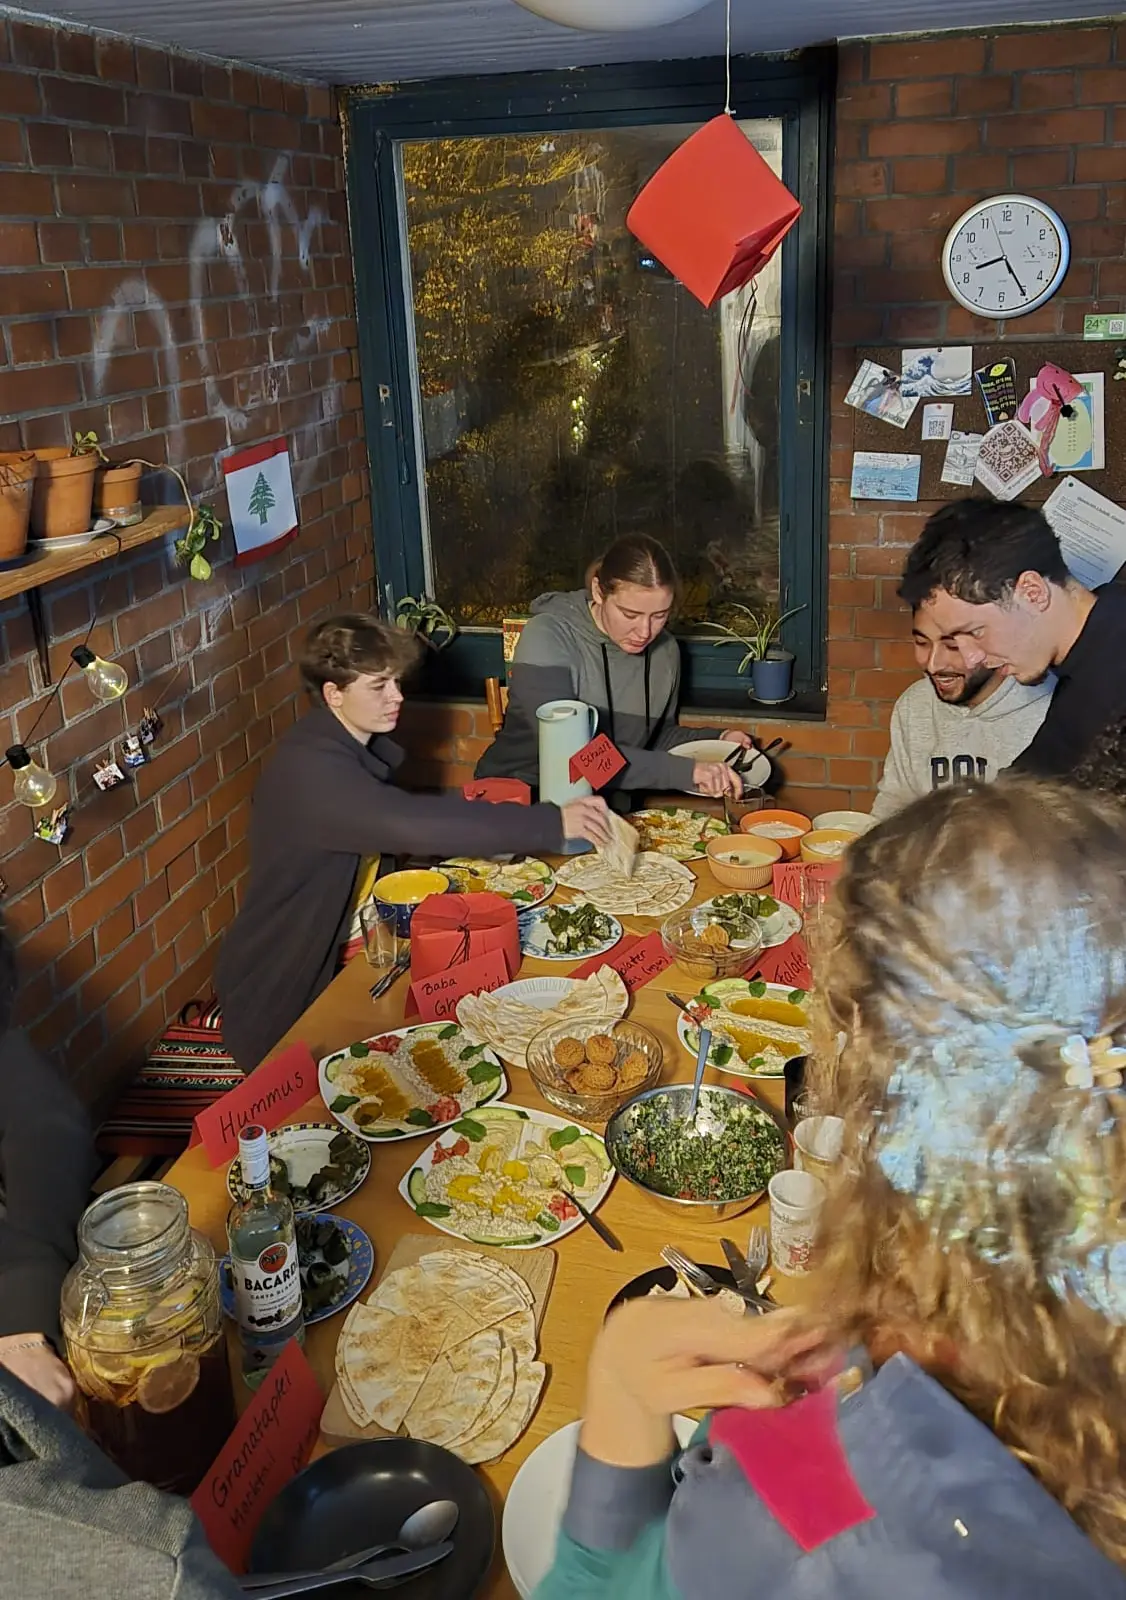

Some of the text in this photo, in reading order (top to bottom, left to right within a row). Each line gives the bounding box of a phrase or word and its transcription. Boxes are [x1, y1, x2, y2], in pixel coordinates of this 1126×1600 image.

[1001, 210, 1012, 222] 12
[1025, 214, 1030, 226] 1
[981, 218, 989, 230] 11
[966, 232, 976, 243] 10
[1039, 228, 1046, 240] 2
[956, 254, 962, 262] 9
[1047, 251, 1054, 259] 3
[963, 272, 970, 283] 8
[1036, 270, 1043, 281] 4
[977, 286, 985, 298] 7
[998, 291, 1005, 303] 6
[421, 977, 458, 996] Baba
[219, 1071, 304, 1144] Hummus
[244, 1260, 298, 1292] BACARD
